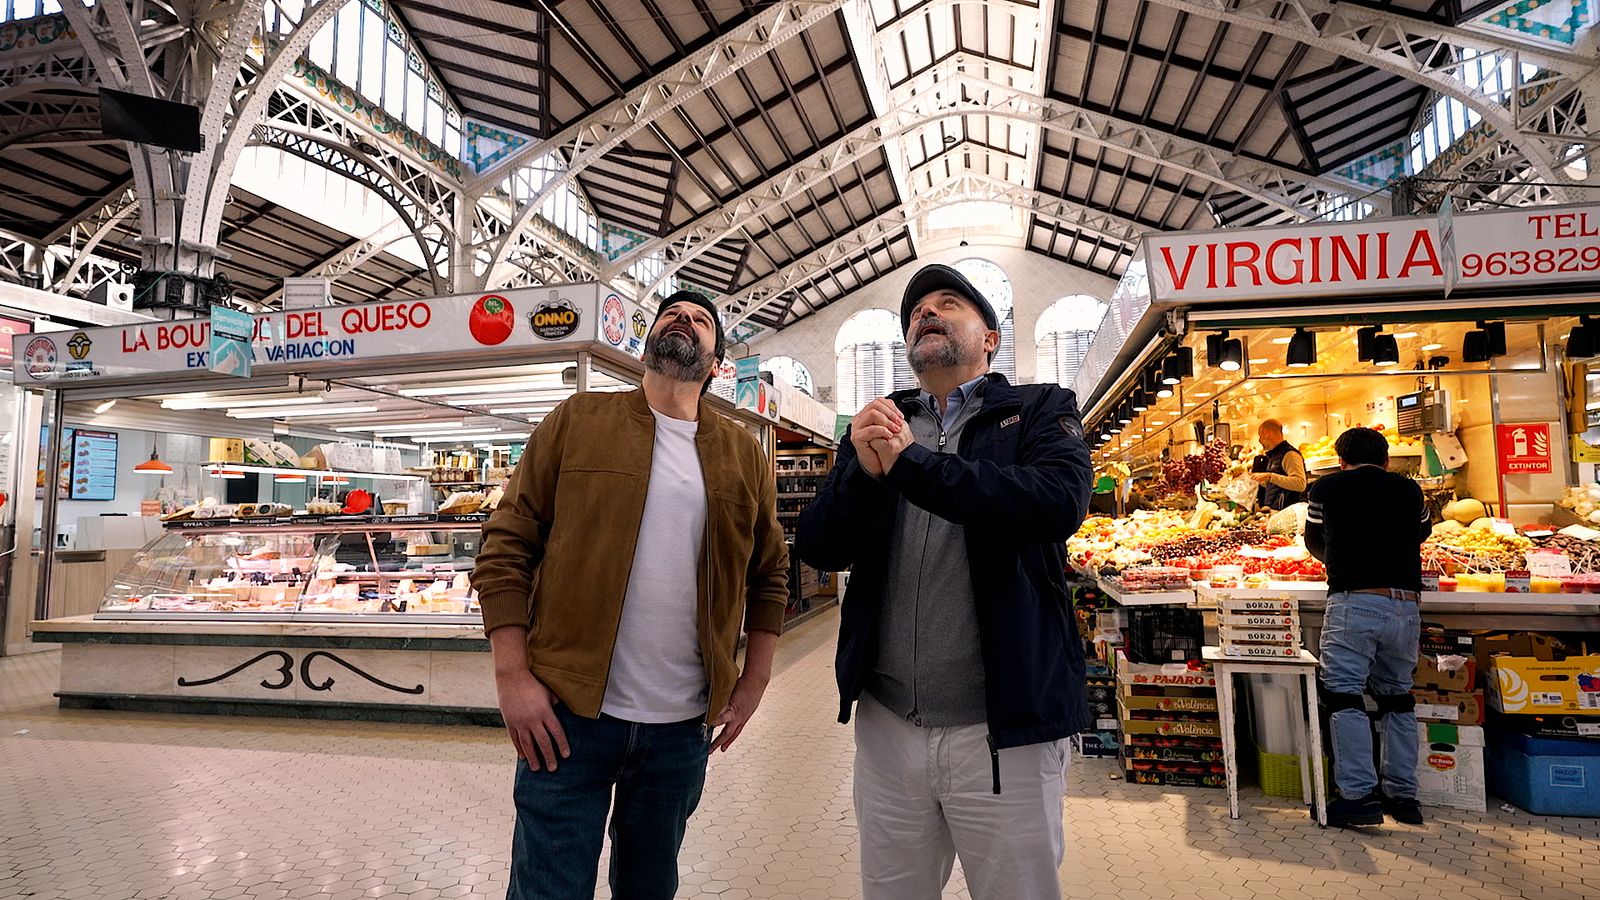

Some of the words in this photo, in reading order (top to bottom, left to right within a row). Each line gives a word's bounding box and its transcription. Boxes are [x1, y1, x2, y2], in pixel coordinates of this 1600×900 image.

[1528, 212, 1599, 240] TEL
[1159, 228, 1445, 290] VIRGINIA
[1462, 246, 1600, 278] 963829
[122, 328, 150, 353] LA
[286, 312, 328, 339] DEL
[341, 301, 432, 335] QUESO
[534, 311, 575, 326] ONNO
[265, 338, 355, 362] VARIACION
[1509, 461, 1548, 470] EXTINTOR
[1152, 674, 1205, 685] PAJARO
